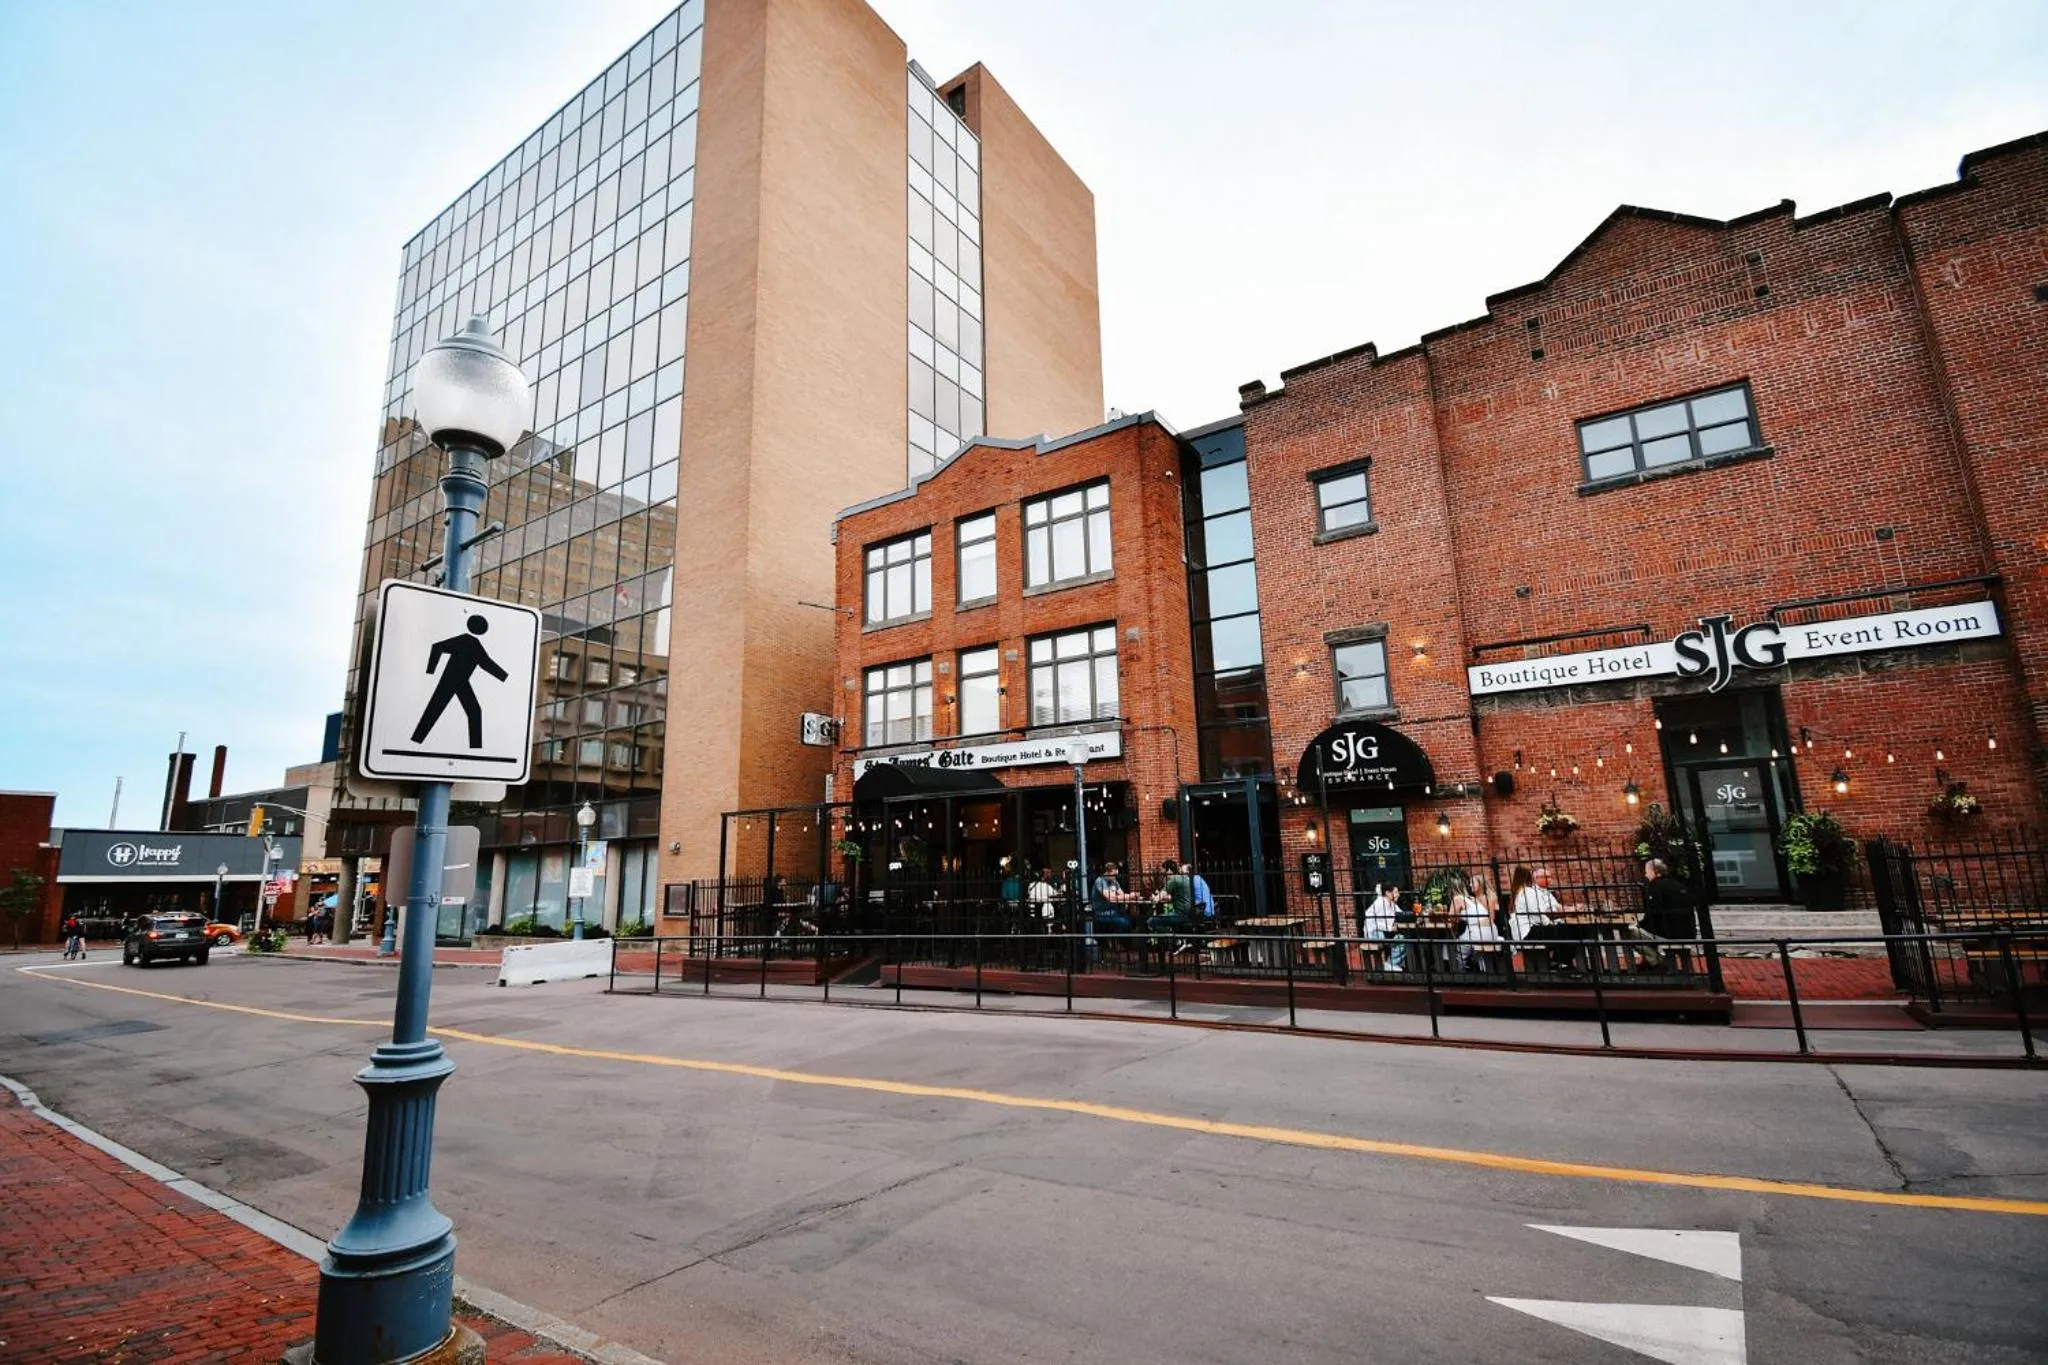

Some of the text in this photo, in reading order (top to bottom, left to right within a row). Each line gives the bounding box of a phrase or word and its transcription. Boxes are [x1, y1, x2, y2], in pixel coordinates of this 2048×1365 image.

[1480, 613, 1982, 694] Boutique Hotel SJG Event Room
[938, 750, 975, 768] Gate
[981, 753, 1018, 764] Boutique
[1020, 749, 1042, 760] Hotel
[1055, 743, 1105, 757] Reant
[1331, 731, 1379, 770] SJG
[1716, 784, 1747, 803] SJG
[139, 844, 182, 861] Happy
[1368, 835, 1390, 853] SJG
